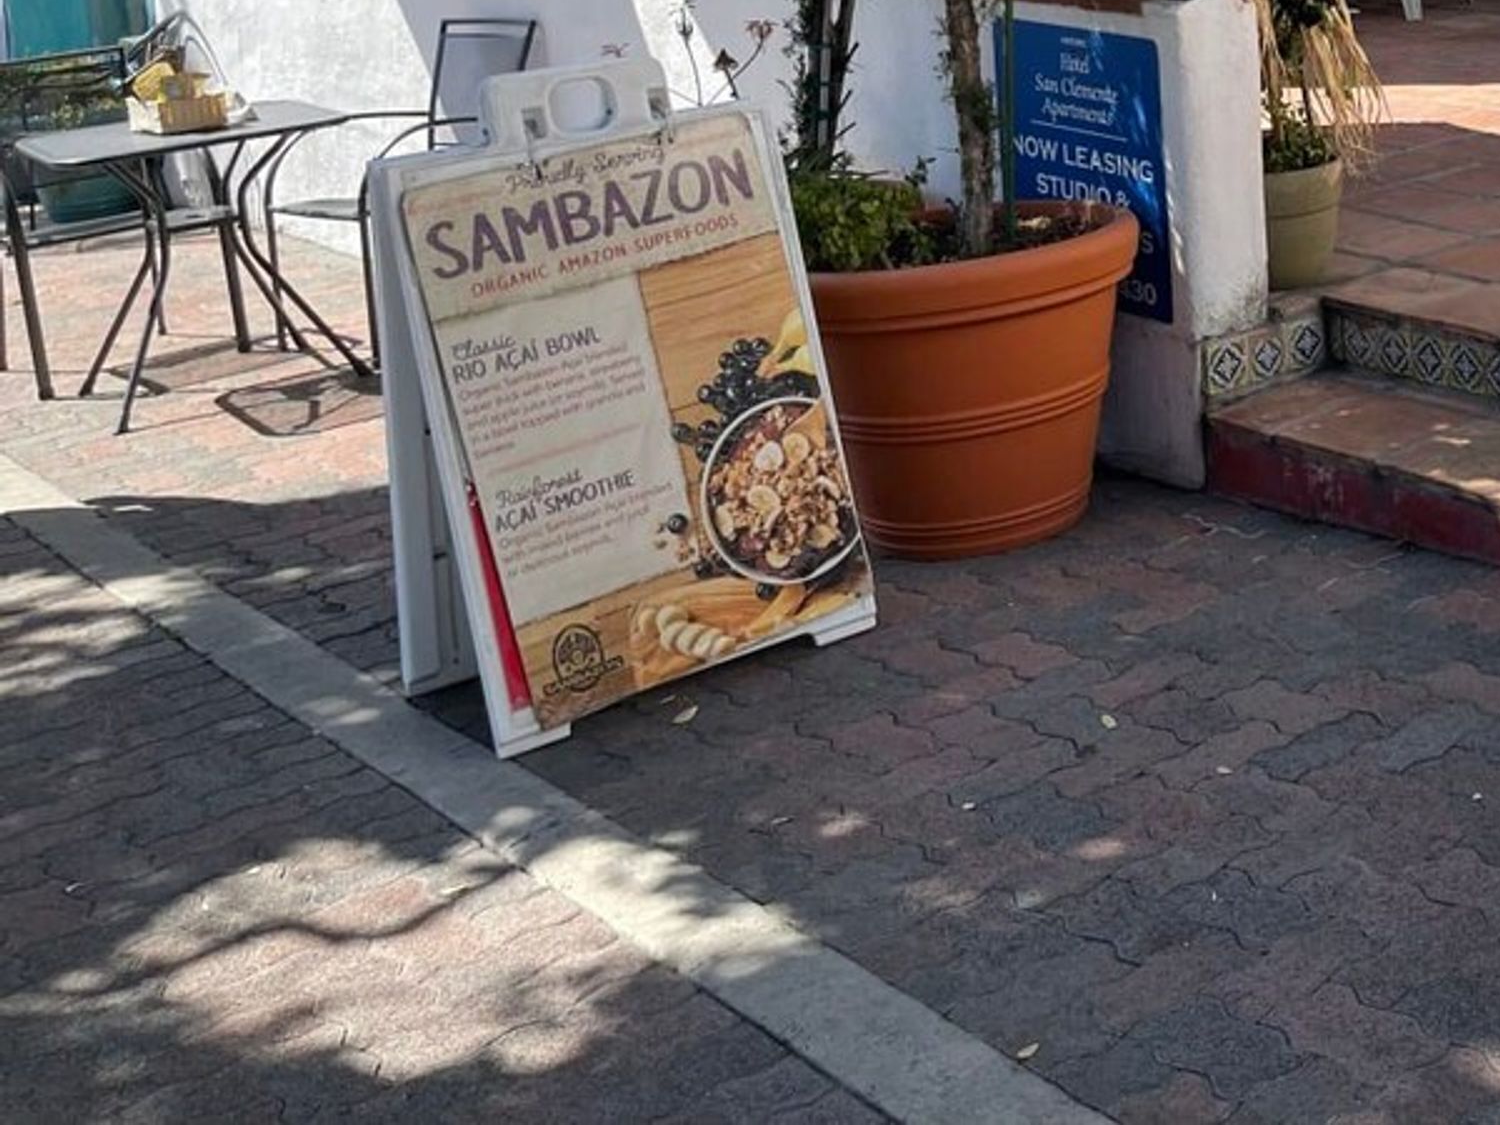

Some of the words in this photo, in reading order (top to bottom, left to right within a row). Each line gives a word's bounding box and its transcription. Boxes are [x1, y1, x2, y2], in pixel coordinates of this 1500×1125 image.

[1034, 72, 1059, 94] San
[593, 146, 665, 174] Serving
[1013, 134, 1059, 163] NOW
[1061, 142, 1154, 183] LEASING
[1036, 172, 1112, 205] STUDIO
[426, 147, 755, 280] SAMBAZON
[470, 262, 549, 300] ORGANIC
[558, 243, 628, 275] AMAZON
[634, 212, 740, 254] SUPERFOODS
[452, 358, 487, 384] RIO
[544, 326, 601, 357] BOWL
[543, 469, 634, 515] SMOOTHIE
